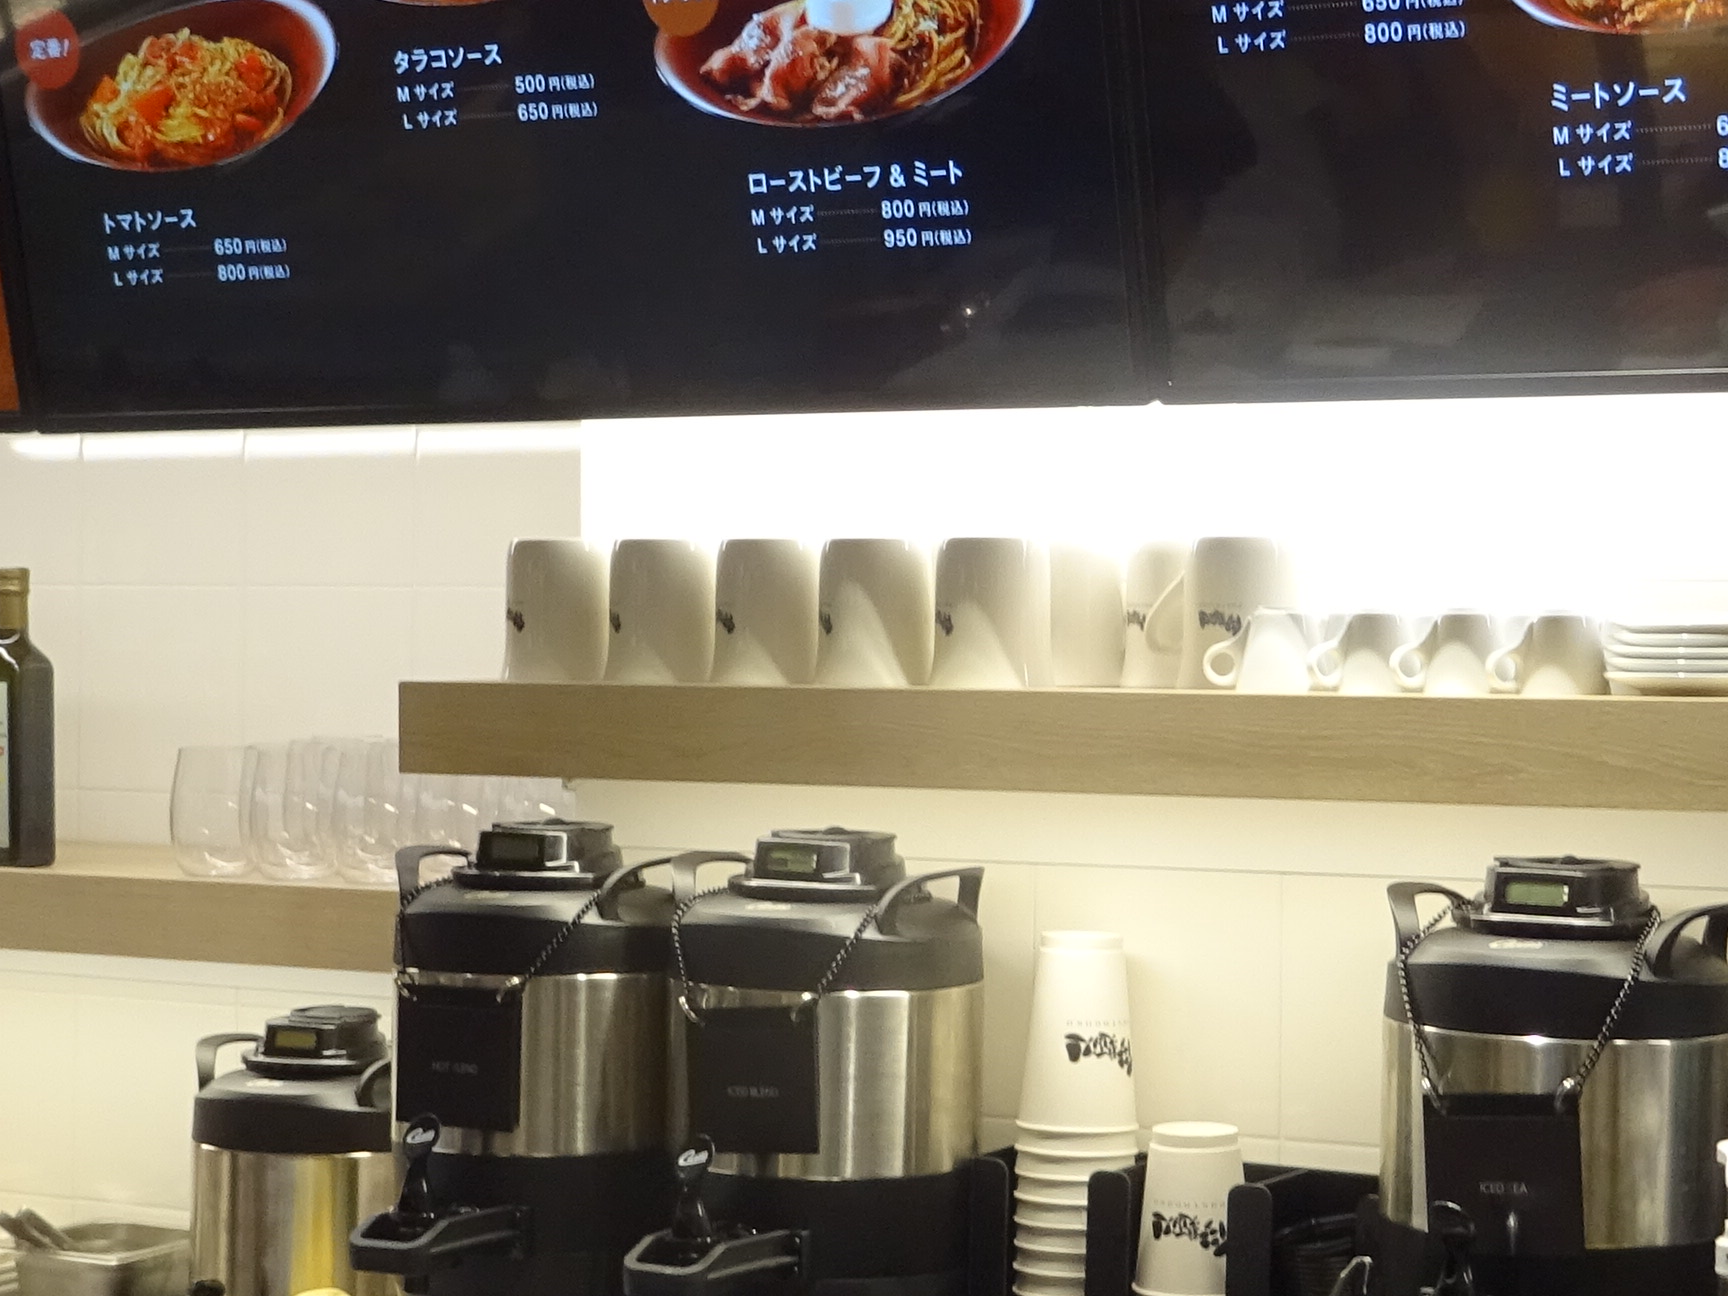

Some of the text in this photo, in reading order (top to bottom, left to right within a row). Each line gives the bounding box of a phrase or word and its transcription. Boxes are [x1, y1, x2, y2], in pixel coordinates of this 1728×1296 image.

[1364, 21, 1403, 44] 800
[393, 44, 502, 74] タラコソース
[1551, 77, 1686, 112] ミートソース
[747, 165, 881, 194] ローストビーフ
[913, 160, 963, 187] ミート
[103, 208, 197, 235] トマトソース
